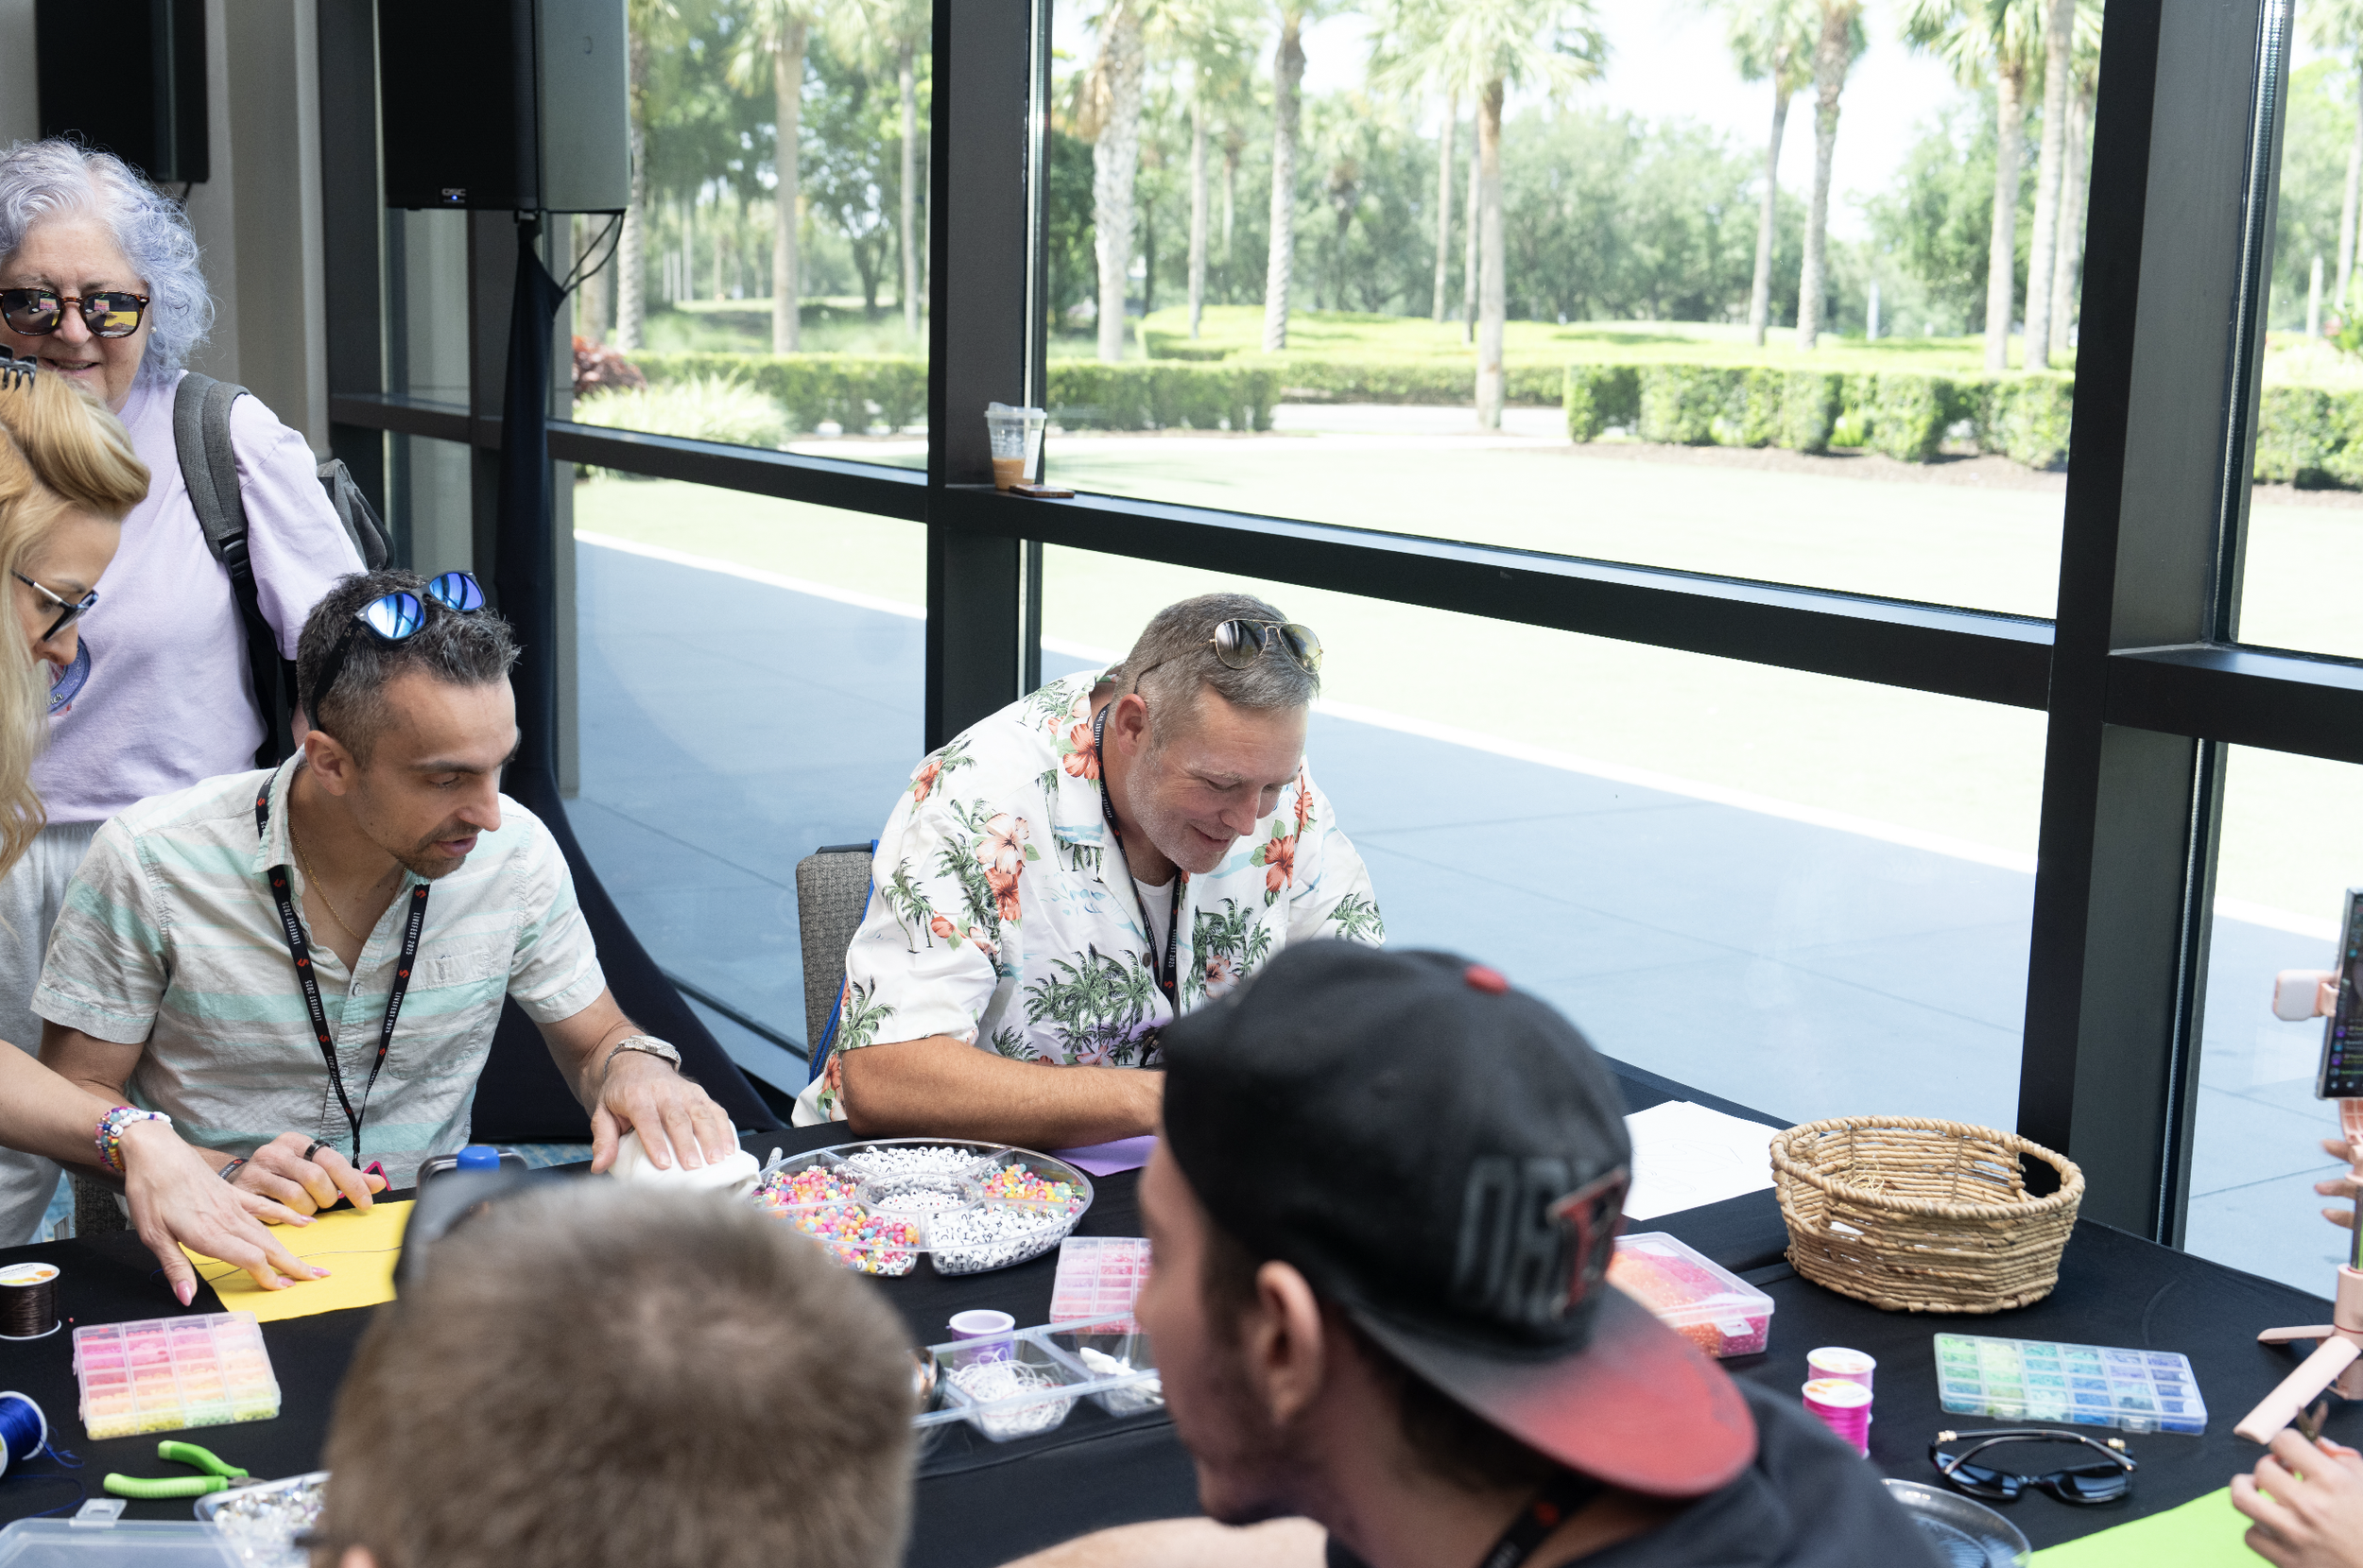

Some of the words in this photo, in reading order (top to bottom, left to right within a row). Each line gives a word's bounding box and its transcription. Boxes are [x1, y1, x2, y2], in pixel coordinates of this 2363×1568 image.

[282, 901, 293, 918] 2025
[286, 918, 301, 945] LIVEFEST
[409, 912, 421, 939] LIVEFEST
[405, 939, 415, 956] 2025
[304, 979, 315, 995] 2025
[309, 995, 321, 1021] LIVEFEST
[389, 991, 402, 1018] LIVEFEST
[385, 1019, 394, 1033] 2025
